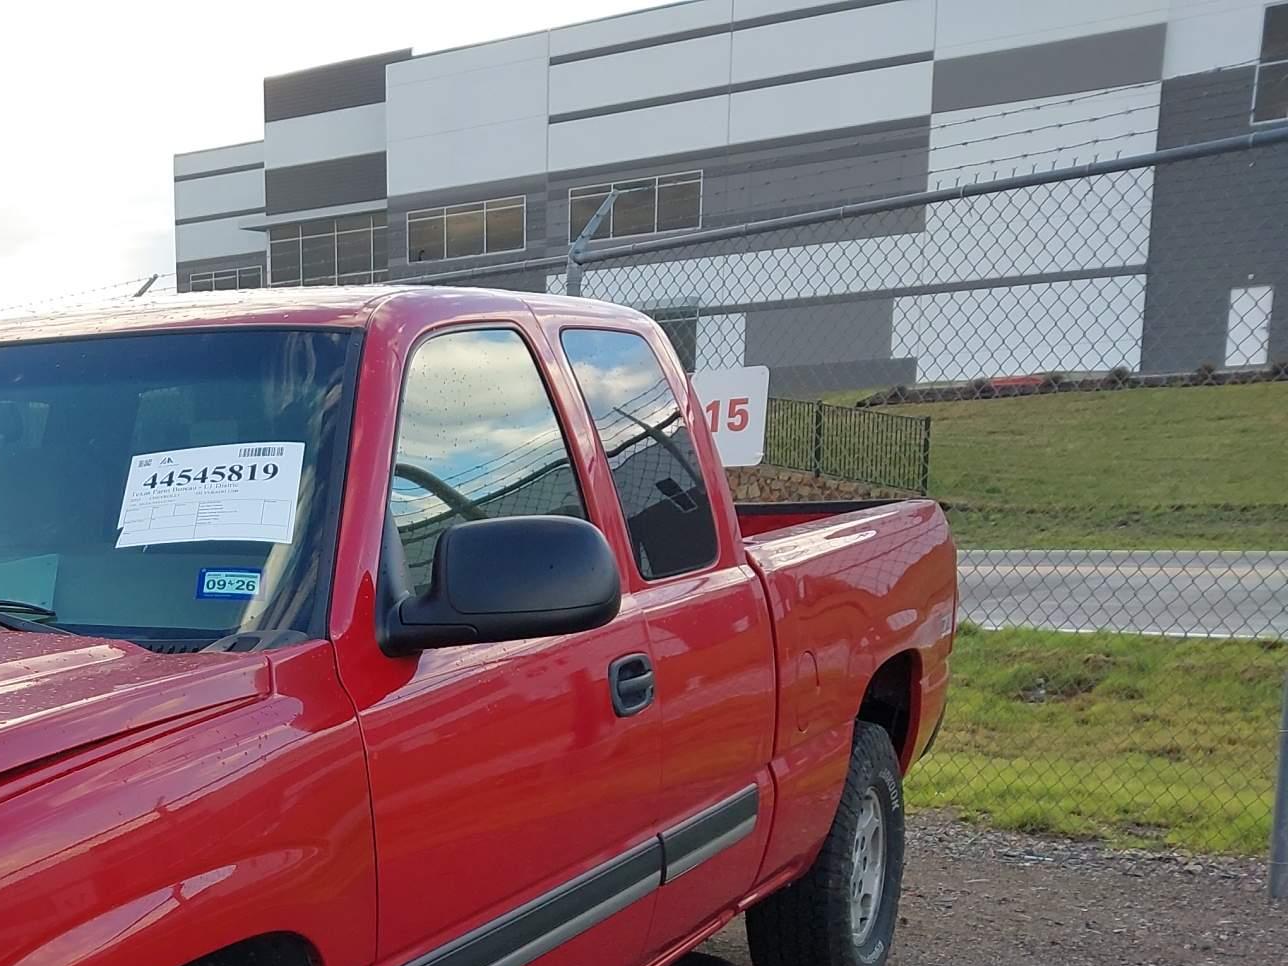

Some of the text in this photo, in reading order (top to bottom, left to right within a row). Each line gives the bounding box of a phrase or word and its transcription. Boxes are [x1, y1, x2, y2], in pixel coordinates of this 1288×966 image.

[705, 397, 749, 433] 15
[143, 463, 279, 489] 44545819
[206, 579, 257, 592] 09 26
